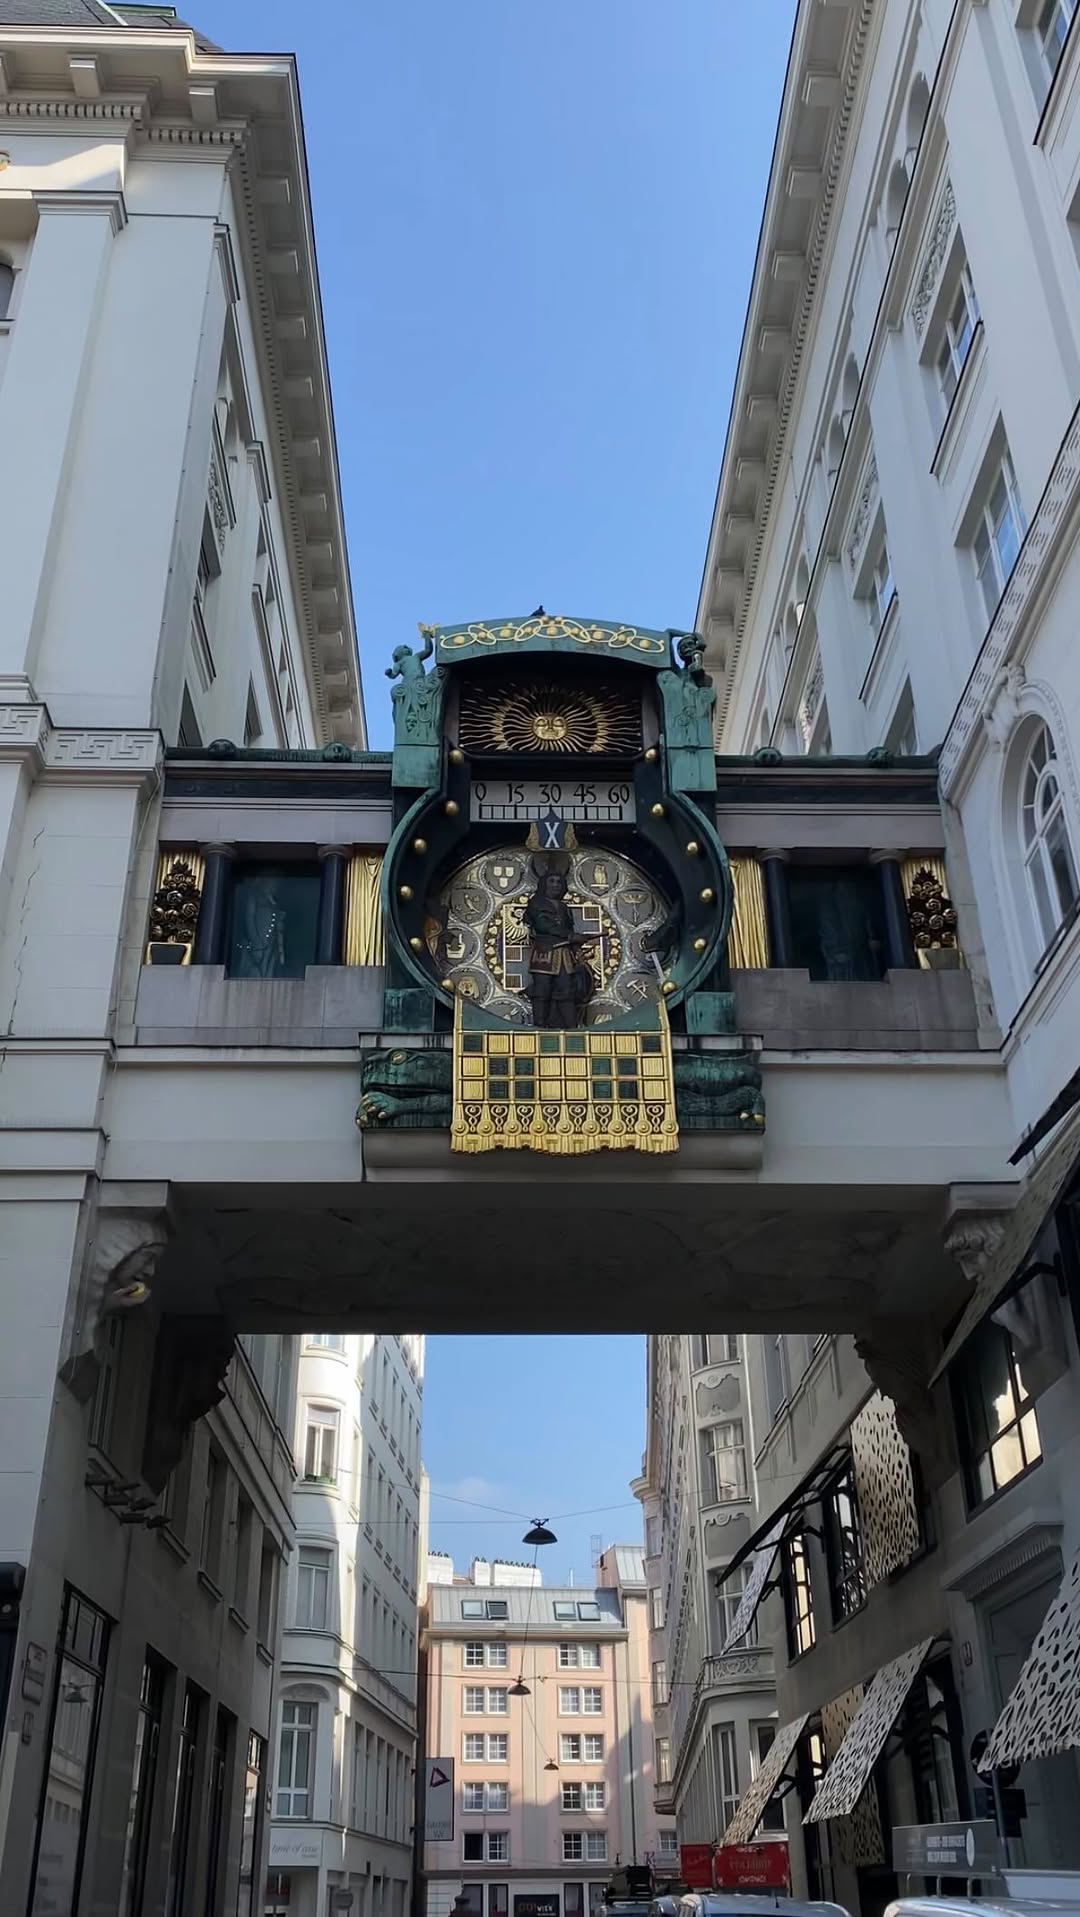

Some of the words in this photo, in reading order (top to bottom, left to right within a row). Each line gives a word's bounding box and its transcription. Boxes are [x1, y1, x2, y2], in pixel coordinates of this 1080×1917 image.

[475, 784, 487, 801] 0
[508, 784, 524, 803] 15
[539, 784, 562, 803] 30
[573, 783, 597, 804] 45
[608, 784, 630, 804] 60
[544, 822, 560, 848] X
